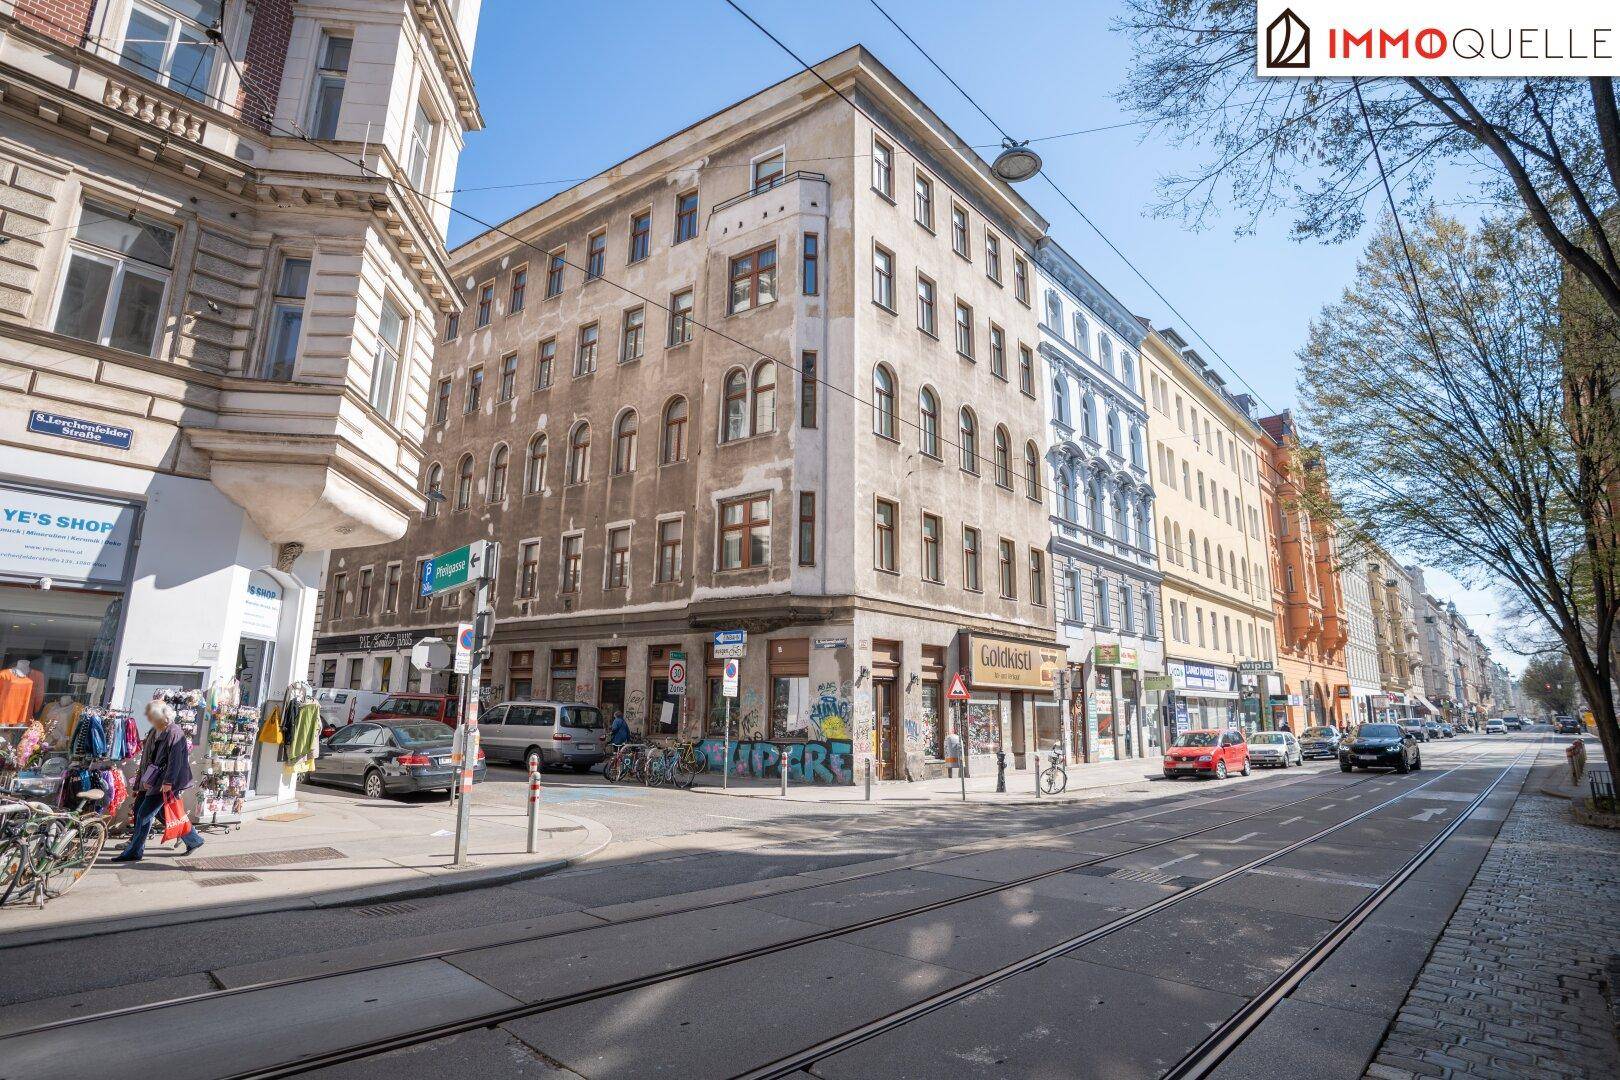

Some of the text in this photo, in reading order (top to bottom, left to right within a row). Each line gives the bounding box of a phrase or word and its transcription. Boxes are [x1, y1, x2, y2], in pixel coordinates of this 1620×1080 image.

[62, 427, 102, 440] Straße
[4, 508, 114, 533] YE'S SHOP
[26, 530, 67, 540] Mineralien
[436, 560, 466, 579] Pfeilgasse
[981, 644, 1032, 671] Goldkistl
[673, 669, 681, 677] 30
[669, 684, 684, 693] Zone
